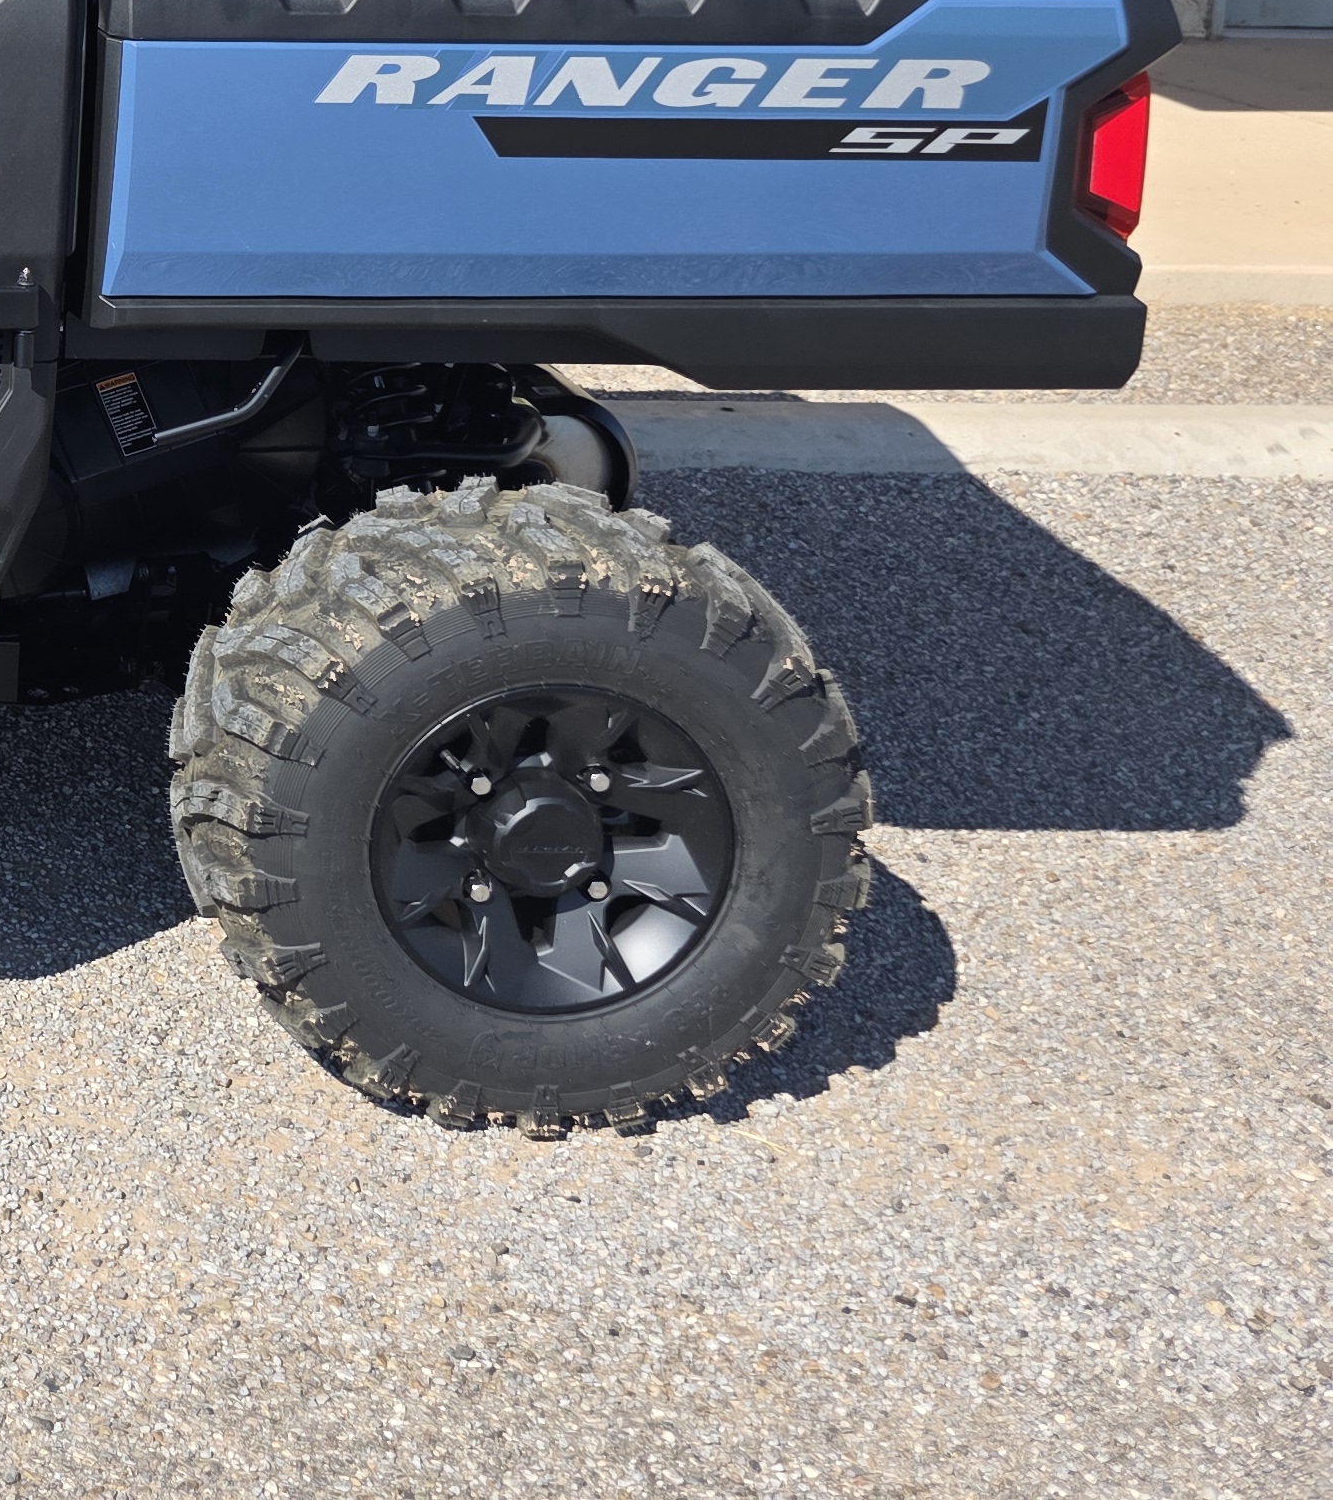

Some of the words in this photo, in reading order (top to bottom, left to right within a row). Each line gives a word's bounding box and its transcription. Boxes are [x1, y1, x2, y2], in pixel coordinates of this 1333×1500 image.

[314, 53, 991, 110] RANGER
[829, 127, 1031, 154] SP
[103, 374, 135, 389] WARNING
